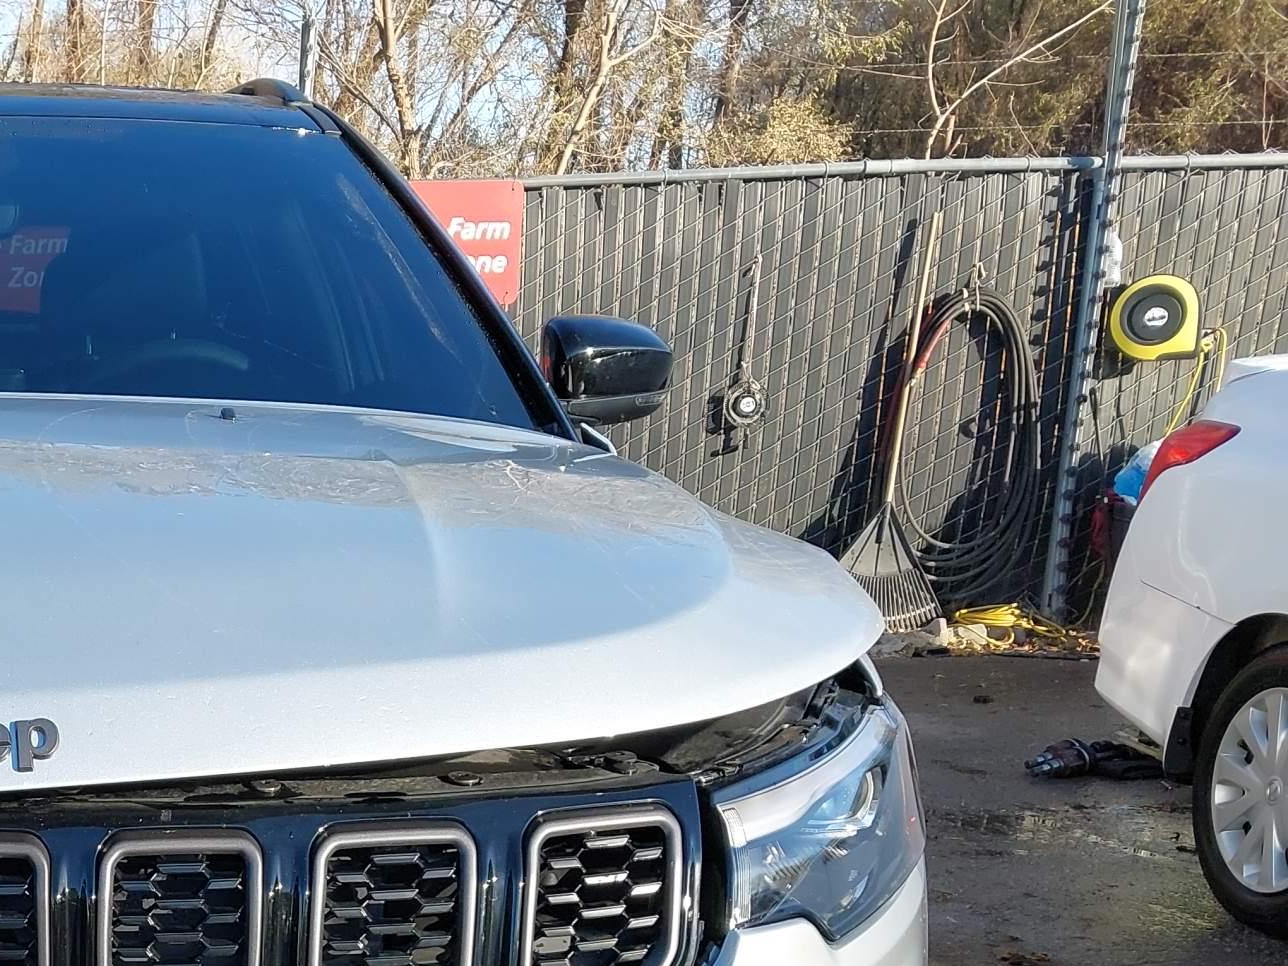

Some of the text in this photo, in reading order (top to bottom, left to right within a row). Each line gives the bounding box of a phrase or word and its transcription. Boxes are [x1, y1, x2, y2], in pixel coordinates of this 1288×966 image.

[447, 217, 511, 240] Farm
[11, 234, 68, 255] Farm
[8, 266, 44, 288] Zo
